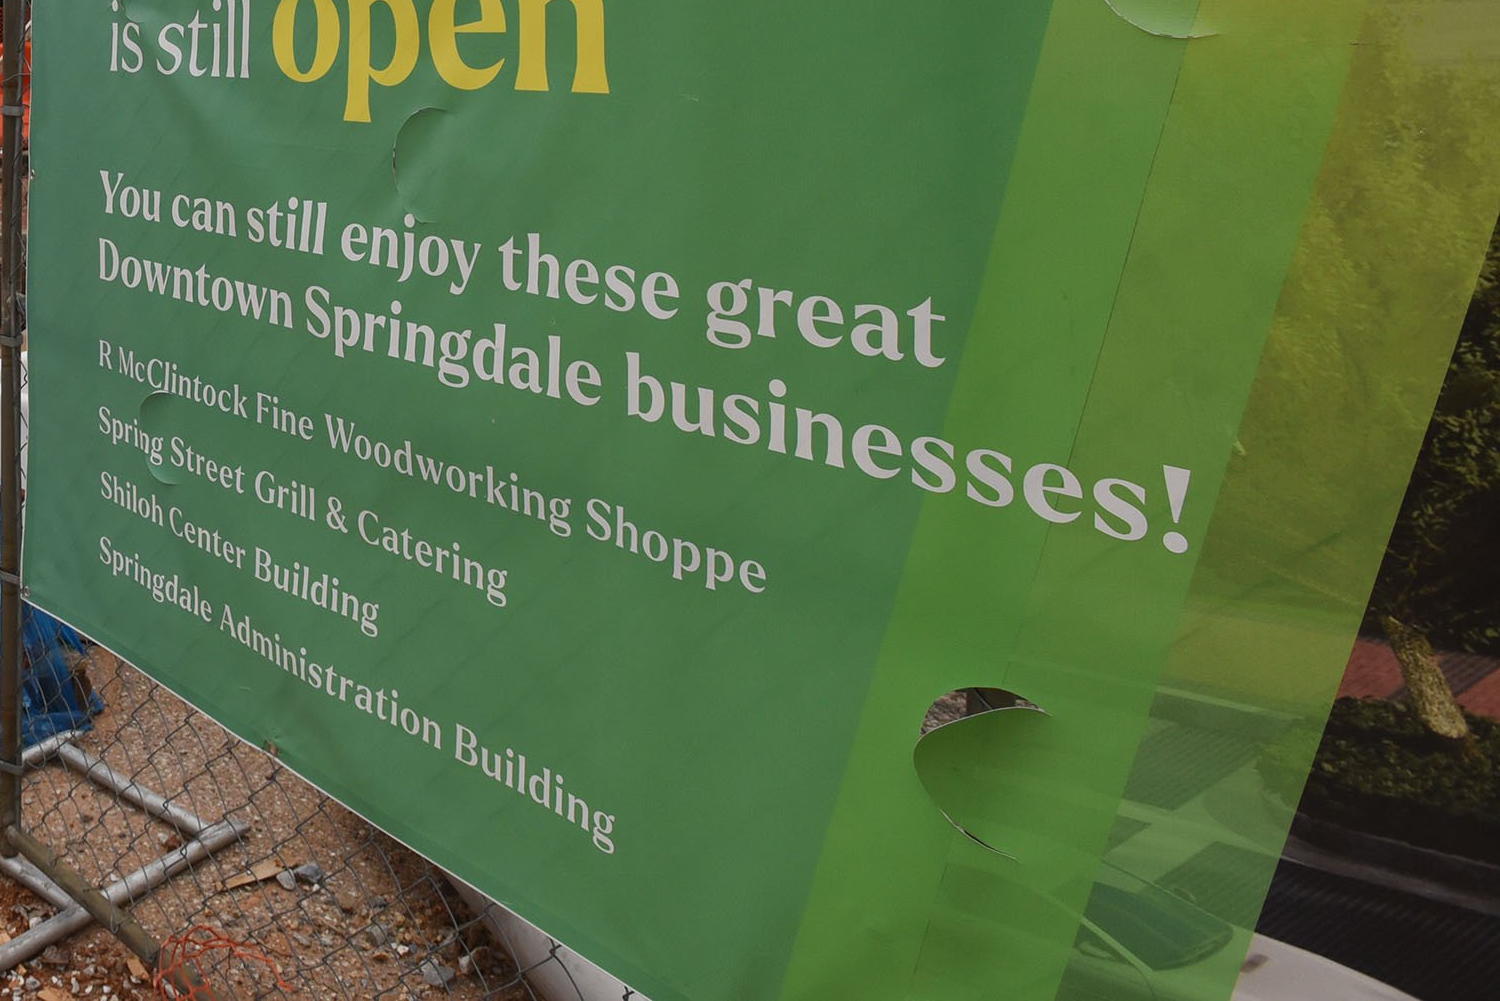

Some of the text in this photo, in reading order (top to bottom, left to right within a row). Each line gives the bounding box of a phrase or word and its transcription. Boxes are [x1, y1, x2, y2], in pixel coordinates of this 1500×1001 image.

[99, 169, 946, 368] You can still enjoy these great
[98, 237, 1192, 554] Downtown Springdale businesses!
[98, 405, 508, 608] Spring Street Grill & Catering
[99, 339, 767, 594] R McClintock Fine Woodworking Shoppe
[100, 471, 380, 638] Shiloh Center Building
[99, 536, 616, 855] Springdale Administration Building
